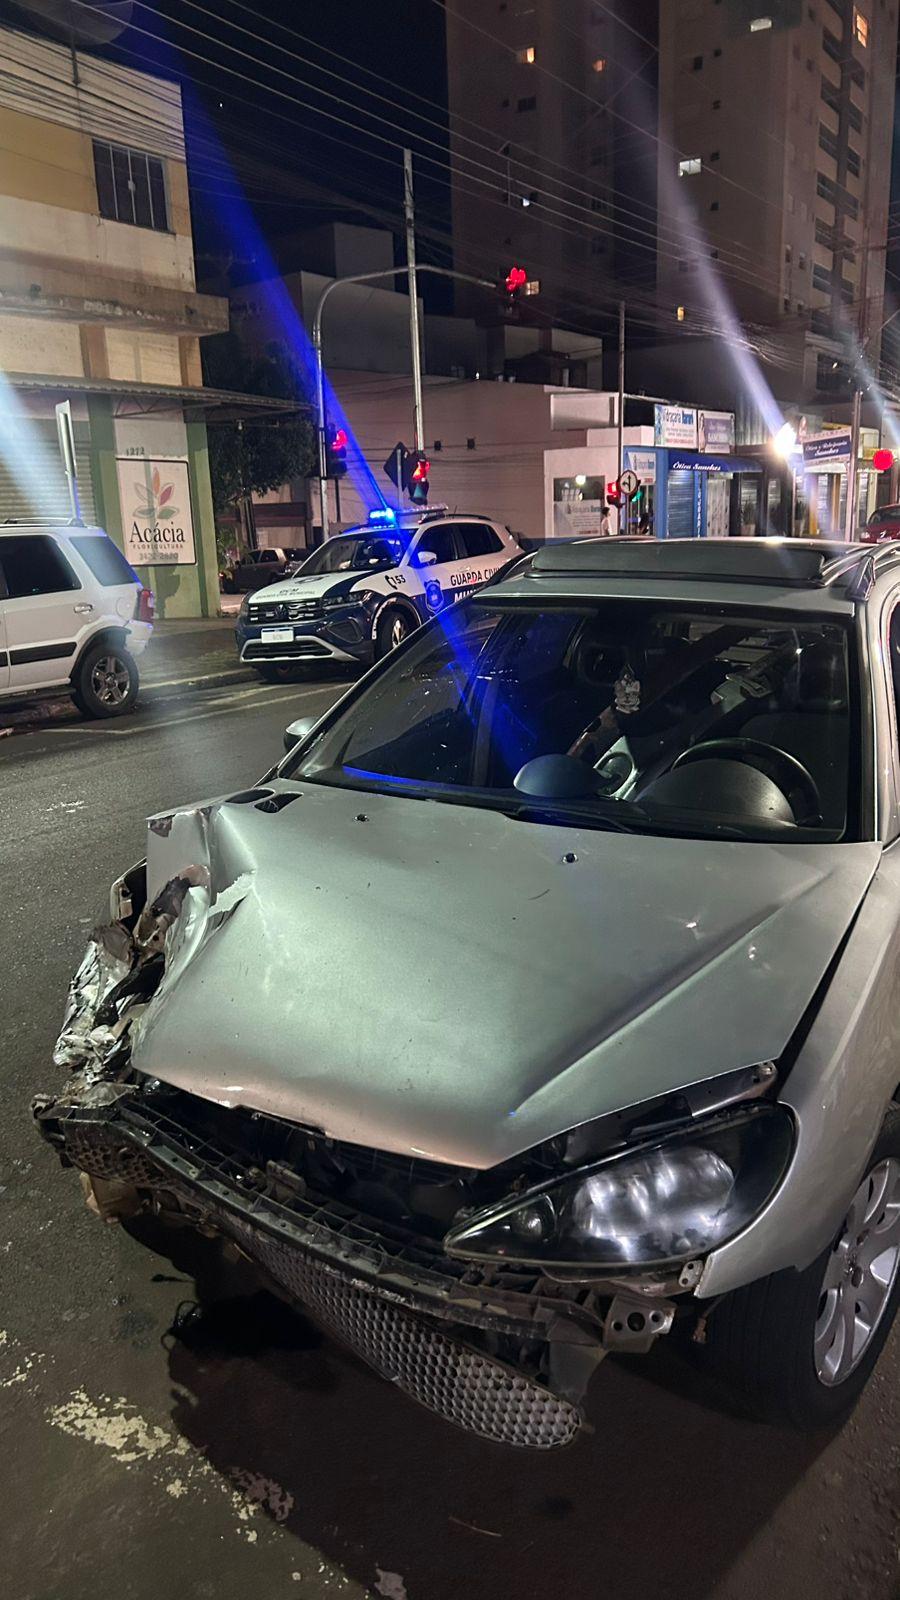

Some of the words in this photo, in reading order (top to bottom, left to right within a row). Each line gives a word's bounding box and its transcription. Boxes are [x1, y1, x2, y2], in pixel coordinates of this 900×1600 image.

[129, 521, 186, 543] Acácia
[391, 574, 406, 585] 153
[450, 570, 483, 587] GUARDA
